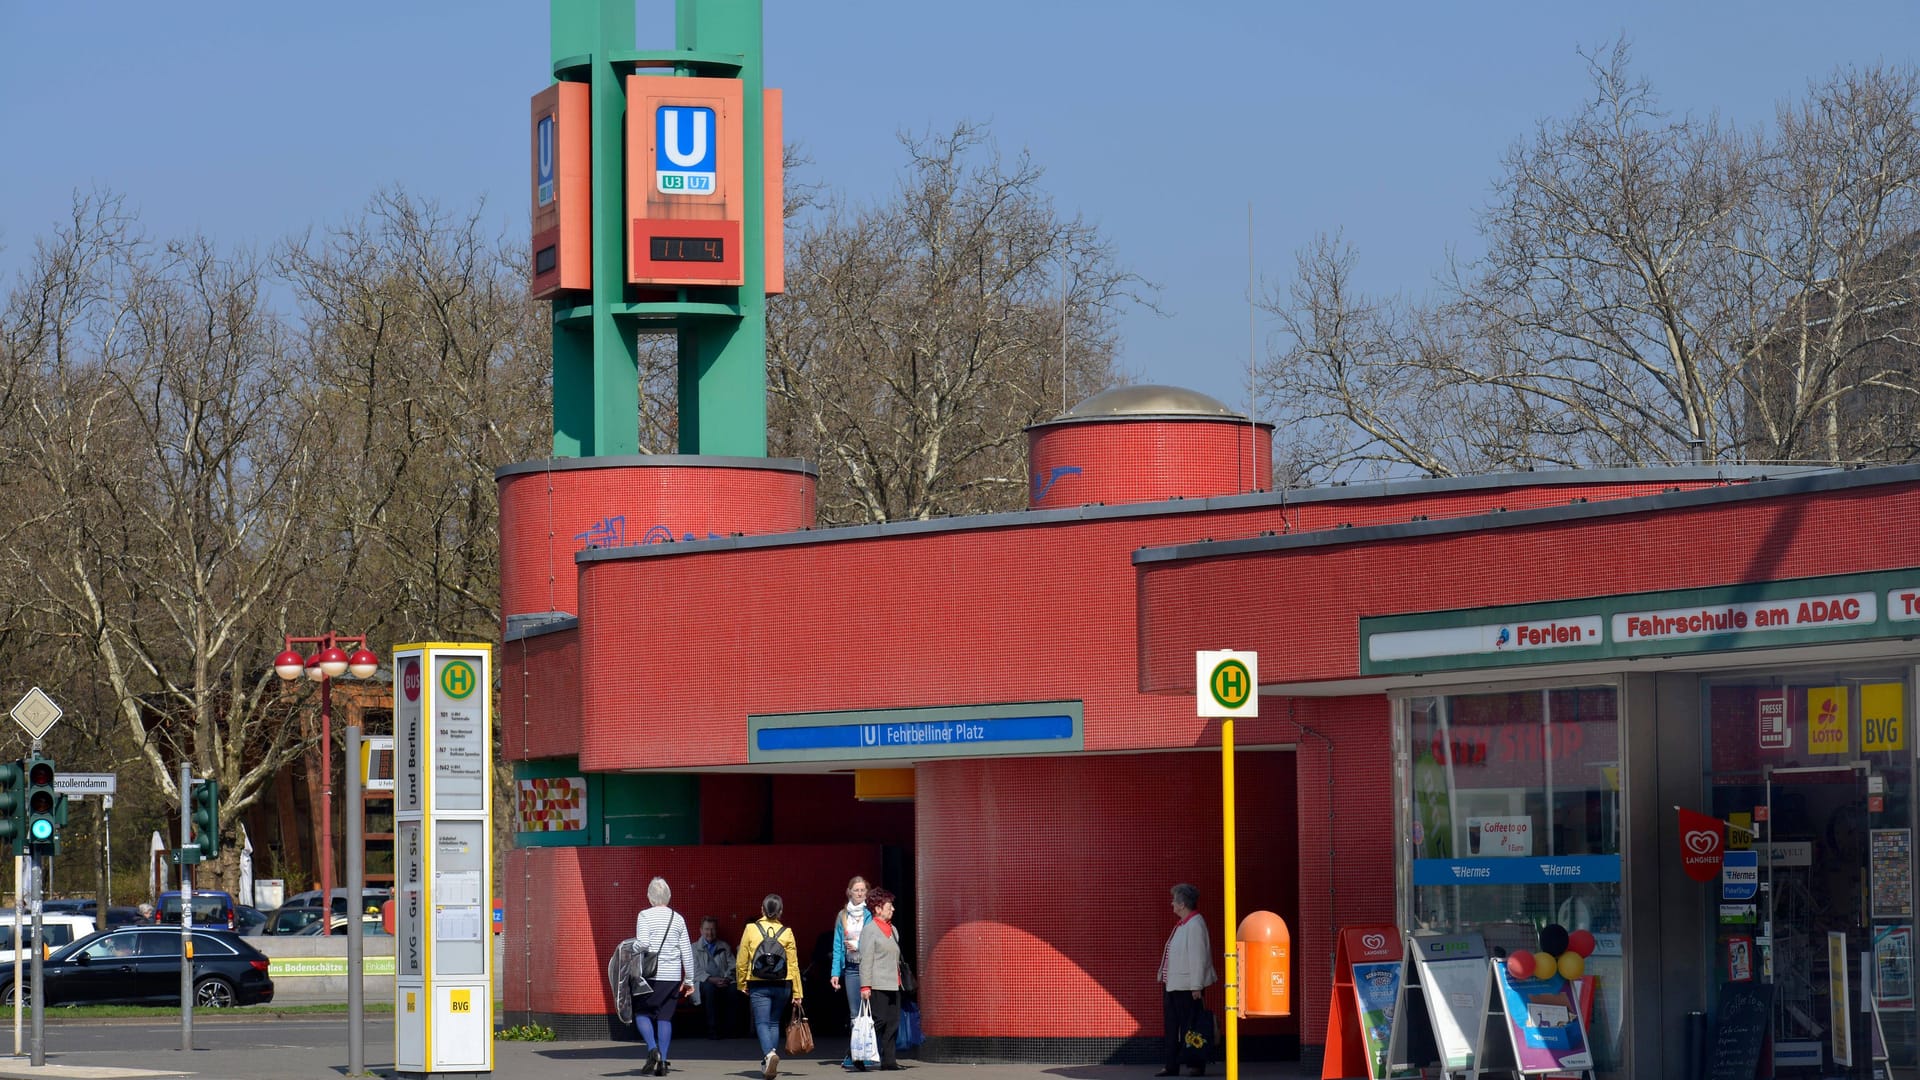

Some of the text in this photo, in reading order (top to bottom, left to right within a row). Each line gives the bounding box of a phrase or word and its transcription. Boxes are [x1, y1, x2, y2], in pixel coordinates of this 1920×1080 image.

[664, 110, 707, 167] U
[539, 121, 552, 178] U
[665, 176, 708, 189] U3 U7
[1628, 598, 1860, 637] Fahrschule am ADAC
[1517, 622, 1581, 646] Ferien
[405, 673, 420, 689] BUS
[450, 669, 467, 691] H
[1222, 671, 1242, 698] H
[1761, 703, 1783, 714] PRESSE
[864, 724, 984, 745] U Fehrbelliner Platz
[1812, 728, 1843, 744] LOTTO
[1866, 717, 1898, 744] BVG
[1501, 719, 1584, 764] SHOP
[408, 717, 417, 805] Und Berlin.
[1484, 822, 1527, 835] Coffee to go
[1732, 830, 1750, 845] BVG
[410, 827, 418, 857] Sie.
[1686, 856, 1721, 865] LANGNESE
[410, 867, 418, 884] für
[1460, 866, 1491, 878] Hermes
[1550, 864, 1582, 877] Hermes
[1732, 870, 1756, 880] Hermes
[410, 890, 418, 918] Gut
[410, 935, 418, 969] BVG
[284, 962, 344, 973] Bodenschätze
[452, 1001, 469, 1011] BVG
